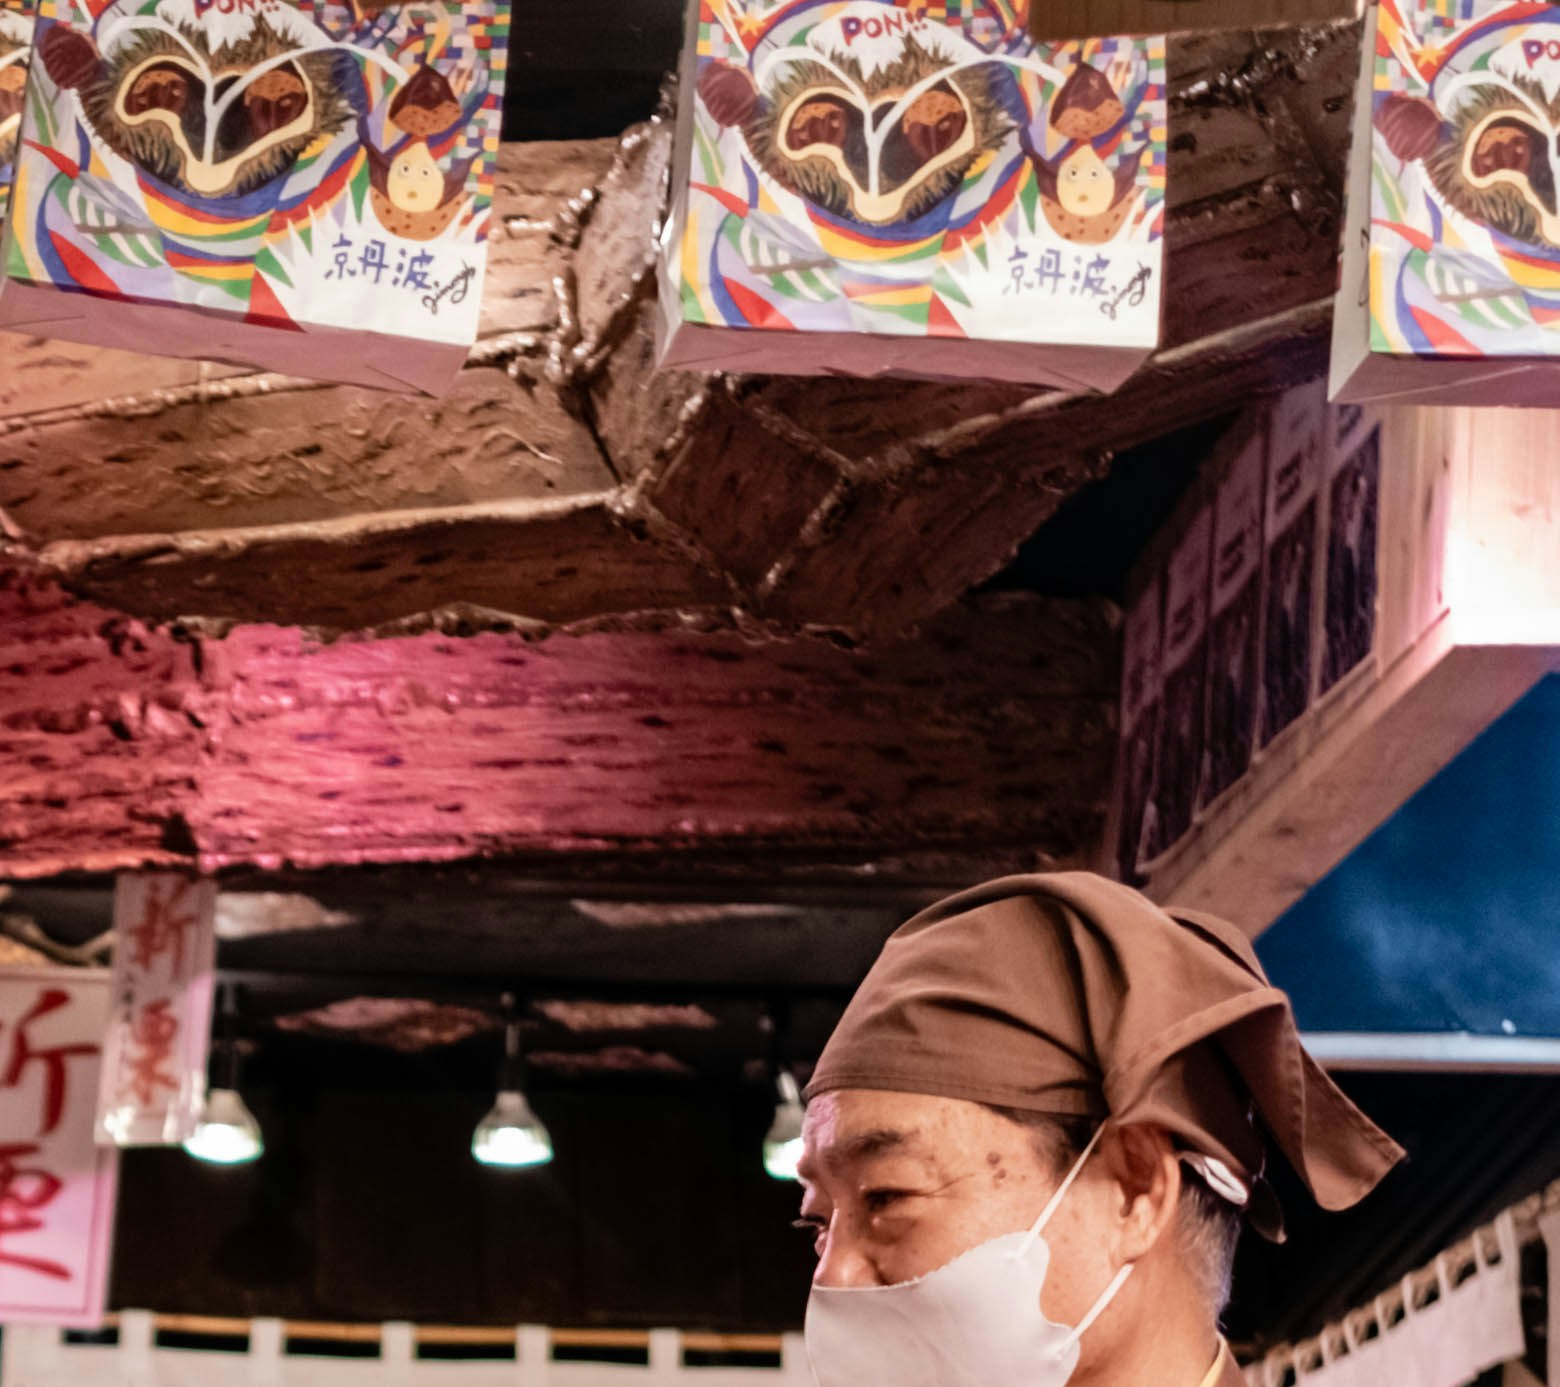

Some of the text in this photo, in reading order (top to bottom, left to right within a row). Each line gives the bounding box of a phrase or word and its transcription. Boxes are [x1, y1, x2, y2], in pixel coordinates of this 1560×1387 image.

[840, 8, 928, 46] PON!!
[324, 233, 436, 289] 京丹波
[1002, 245, 1113, 297] 京丹波
